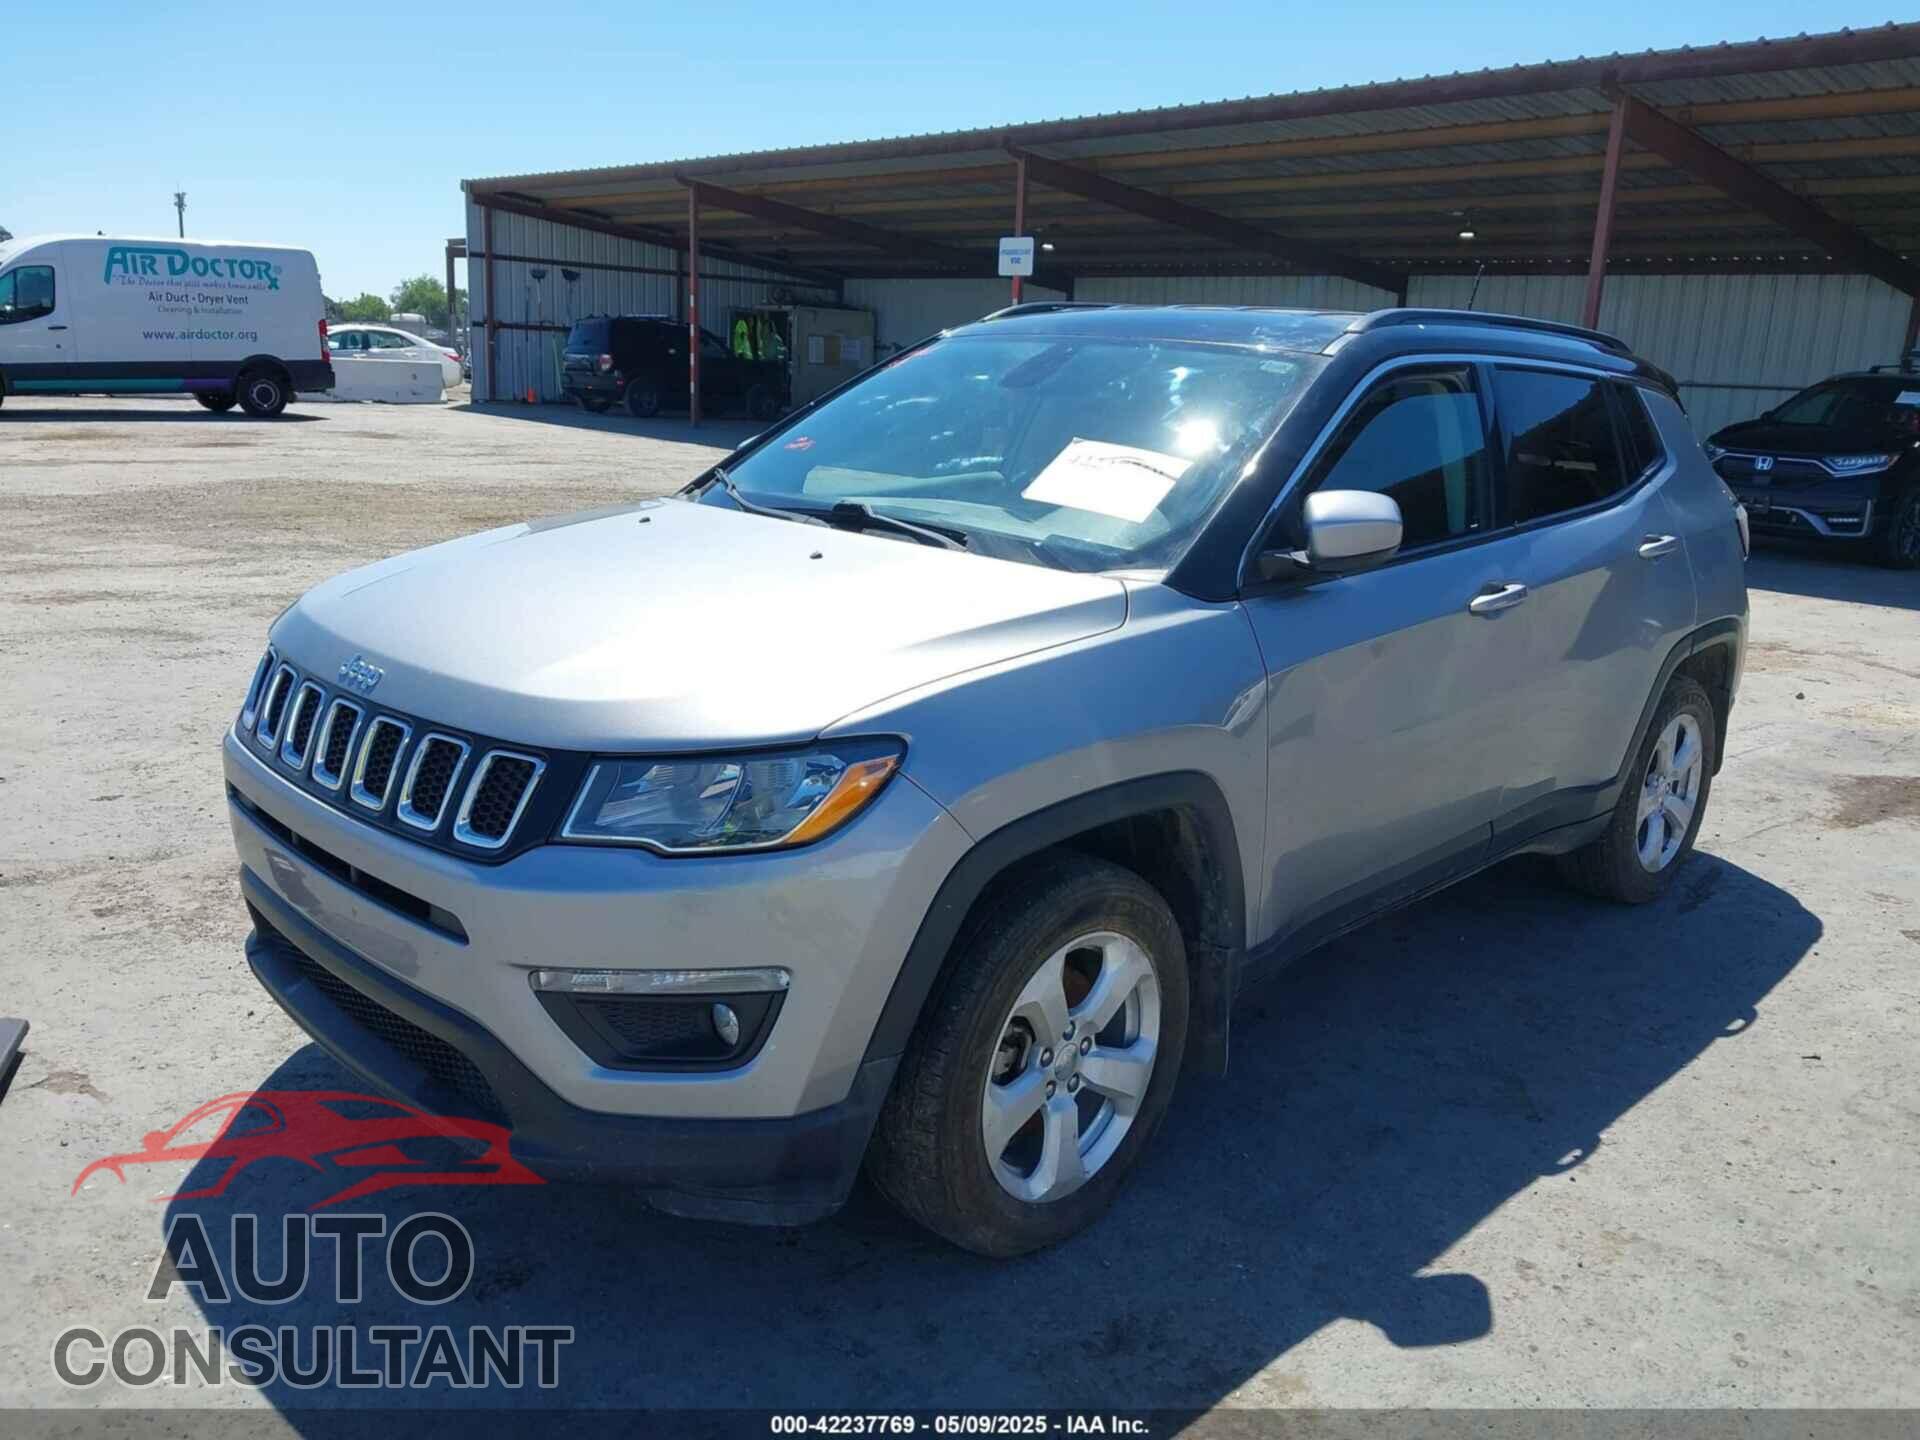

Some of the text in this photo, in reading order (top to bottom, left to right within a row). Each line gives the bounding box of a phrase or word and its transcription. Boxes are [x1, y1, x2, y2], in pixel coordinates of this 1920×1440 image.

[148, 291, 163, 302] Air
[165, 292, 189, 303] Duct
[197, 293, 224, 305] Dryer
[225, 294, 249, 305] Vent
[143, 328, 258, 342] www.airdoctor.org
[339, 656, 384, 689] Jeep
